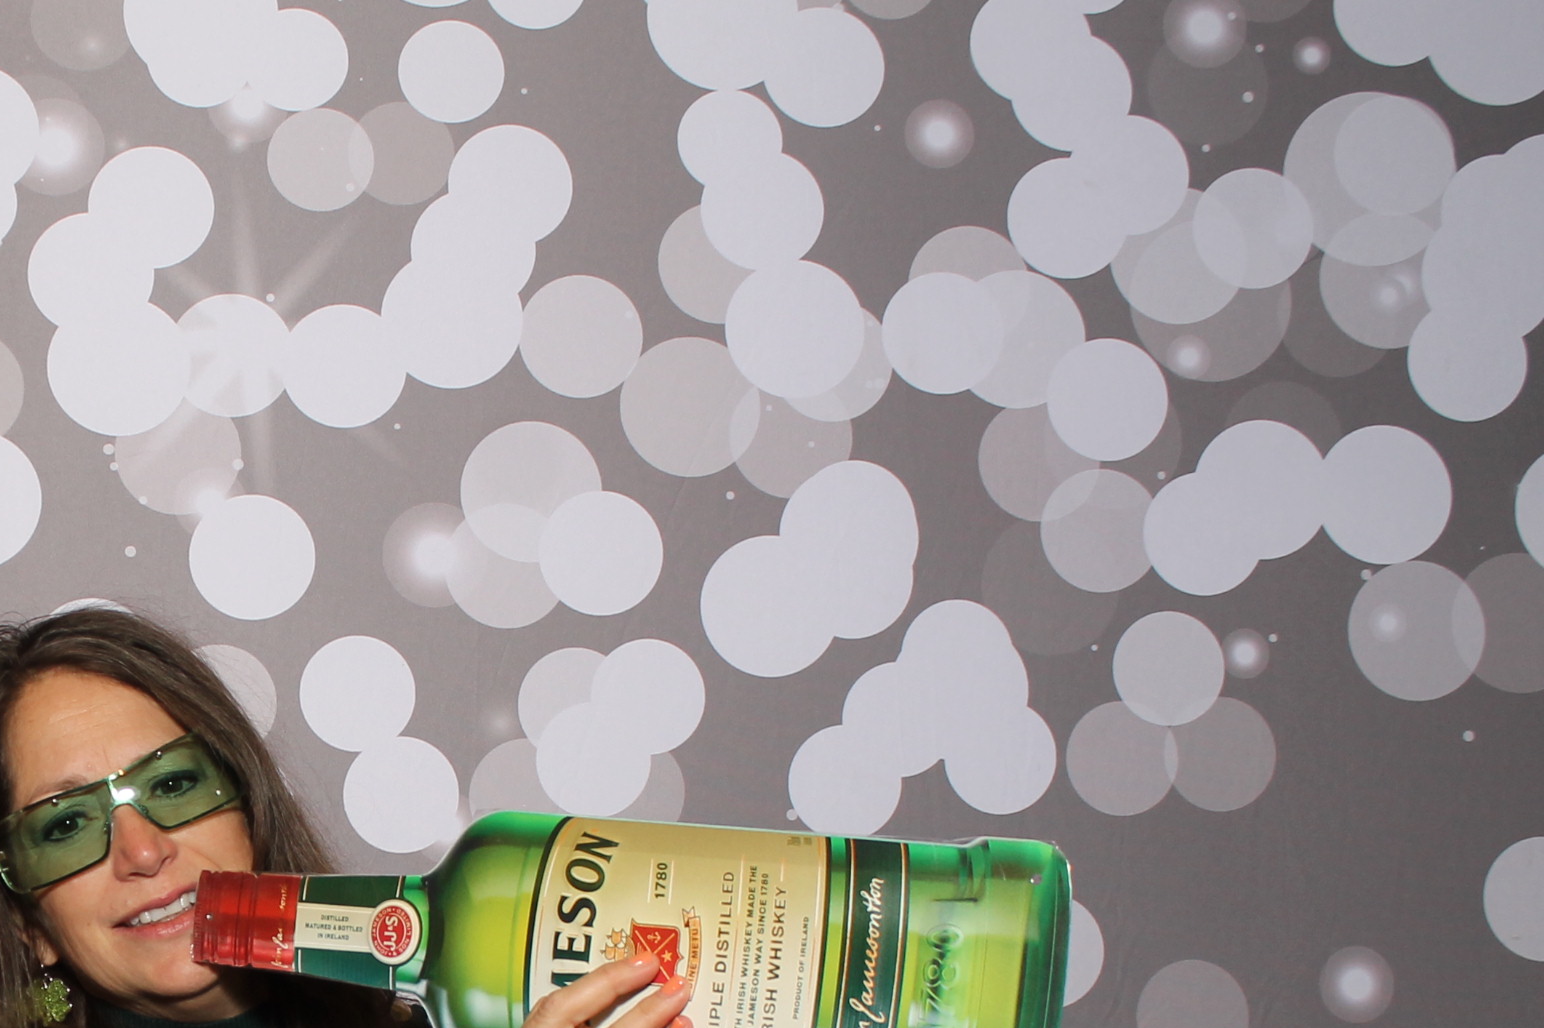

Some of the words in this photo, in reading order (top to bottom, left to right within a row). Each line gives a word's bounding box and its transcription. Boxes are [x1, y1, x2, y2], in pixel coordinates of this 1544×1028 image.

[654, 862, 668, 899] 1780
[749, 865, 758, 883] THE
[760, 873, 769, 895] 1780
[746, 887, 756, 918] MADE
[757, 900, 767, 935] SINCE
[714, 872, 734, 973] DISTILLED
[766, 887, 786, 981] WHISKEY
[800, 916, 809, 957] IRELAND
[691, 928, 699, 959] METU
[740, 921, 753, 977] WHISKEY
[753, 938, 764, 965] WAY
[799, 960, 805, 973] OF
[736, 982, 747, 1014] IRISH
[747, 969, 760, 1026] JAMESON
[792, 976, 804, 1020] PRODUCT
